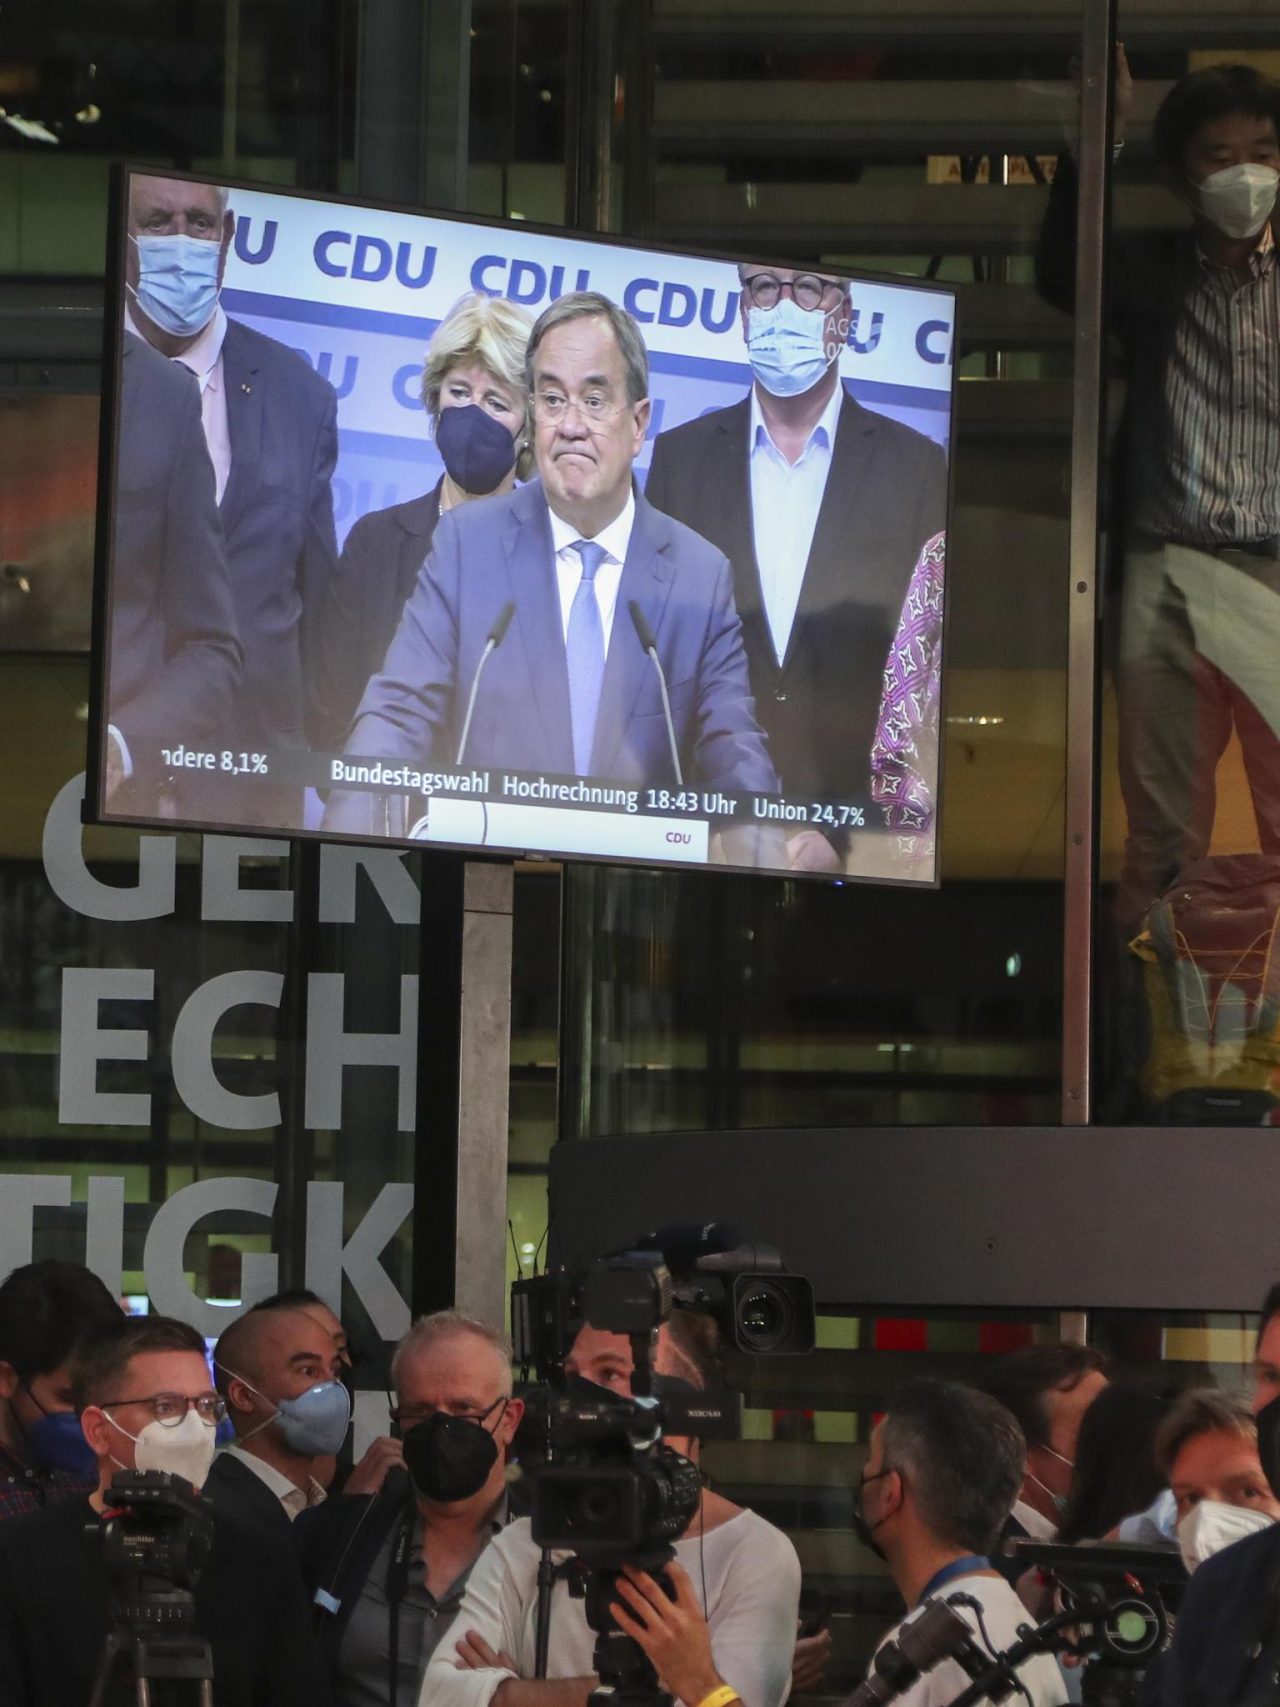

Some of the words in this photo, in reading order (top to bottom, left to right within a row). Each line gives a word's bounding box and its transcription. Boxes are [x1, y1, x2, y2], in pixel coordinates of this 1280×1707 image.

[313, 229, 438, 290] CDU
[470, 254, 591, 306] CDU
[623, 277, 741, 335] CDU
[220, 750, 268, 776] 8,1%
[330, 759, 489, 794] Bundestagswahl
[502, 775, 638, 812] Hochrechnung
[646, 788, 699, 813] 18:43
[703, 792, 738, 816] Uhr
[753, 797, 807, 822] Union
[811, 803, 866, 829] 24,7%
[665, 831, 692, 846] CDU
[58, 966, 419, 1132] ECH
